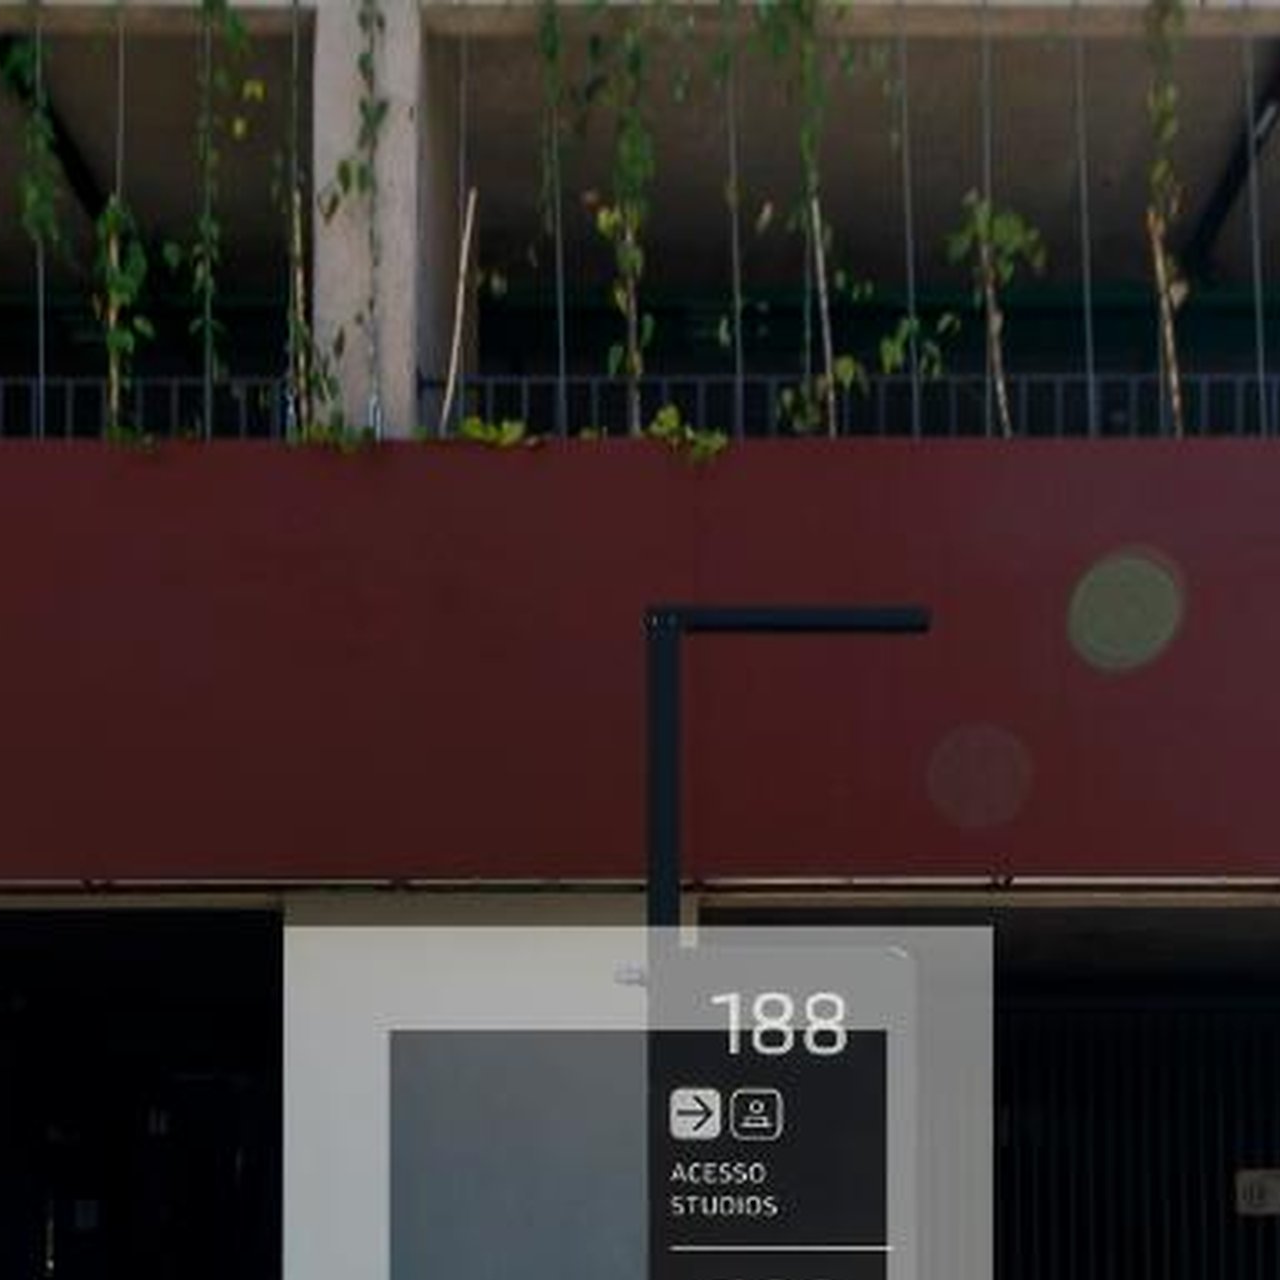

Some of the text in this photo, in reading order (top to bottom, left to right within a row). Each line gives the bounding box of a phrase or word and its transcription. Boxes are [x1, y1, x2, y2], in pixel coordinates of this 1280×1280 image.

[710, 991, 848, 1055] 188
[670, 1161, 767, 1184] ACESSO
[670, 1195, 779, 1217] STUDIOS
